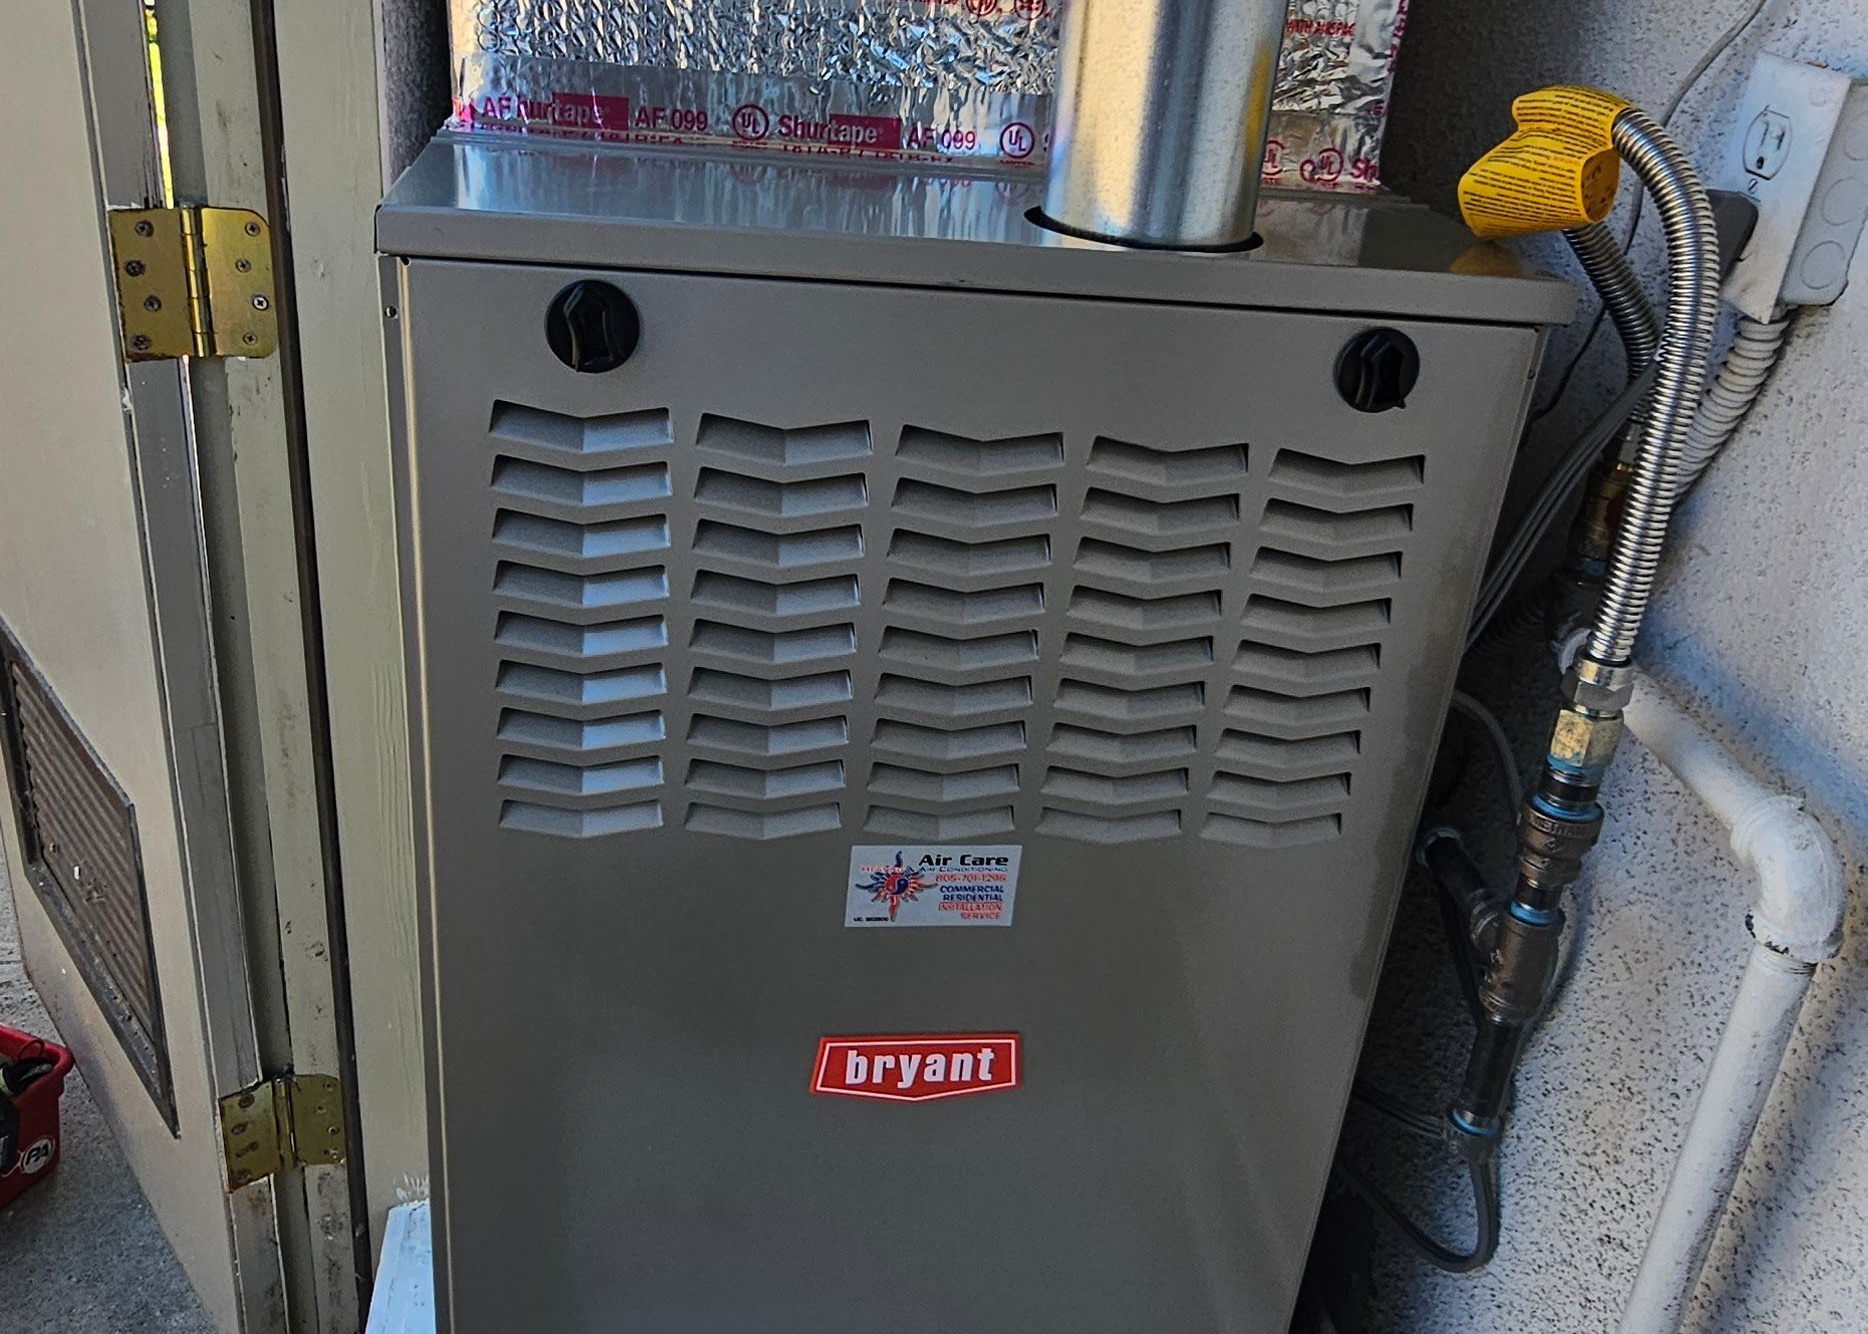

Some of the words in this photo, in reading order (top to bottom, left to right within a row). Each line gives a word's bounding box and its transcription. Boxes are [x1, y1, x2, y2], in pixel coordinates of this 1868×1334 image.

[634, 106, 663, 128] AF
[671, 108, 708, 132] 099
[777, 113, 879, 146] Shurtape
[907, 125, 934, 148] AF
[940, 129, 976, 151] 099
[918, 854, 952, 866] Air
[959, 854, 1009, 866] Care
[940, 885, 1004, 894] COMMERCIAL
[943, 893, 1002, 902] RESIDENTIAL
[938, 902, 1002, 911] INSTALLATION
[961, 911, 1000, 920] SERVICE
[845, 1047, 995, 1089] bryant
